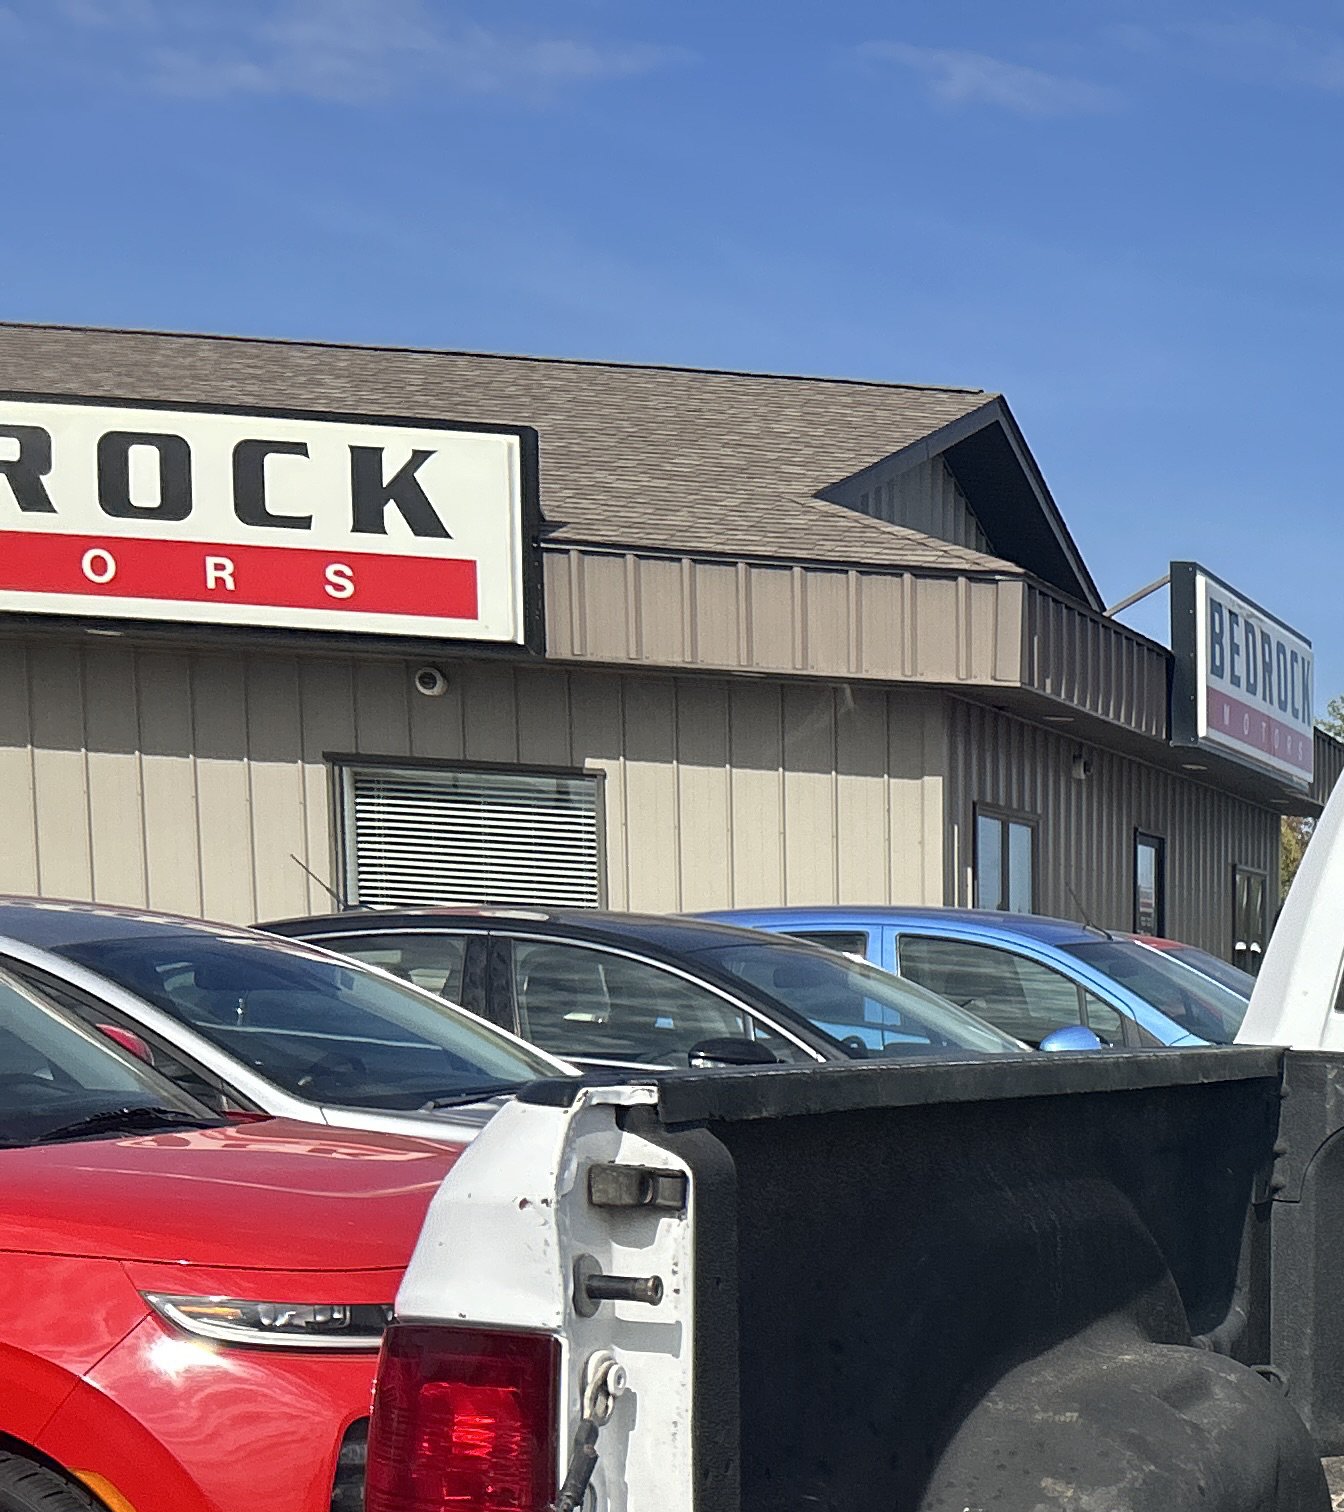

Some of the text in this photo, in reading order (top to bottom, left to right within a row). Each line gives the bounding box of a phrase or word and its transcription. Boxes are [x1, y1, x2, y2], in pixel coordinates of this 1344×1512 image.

[82, 548, 355, 599] ORS
[1210, 598, 1311, 727] BEDROCK
[1223, 704, 1304, 761] MOTORS
